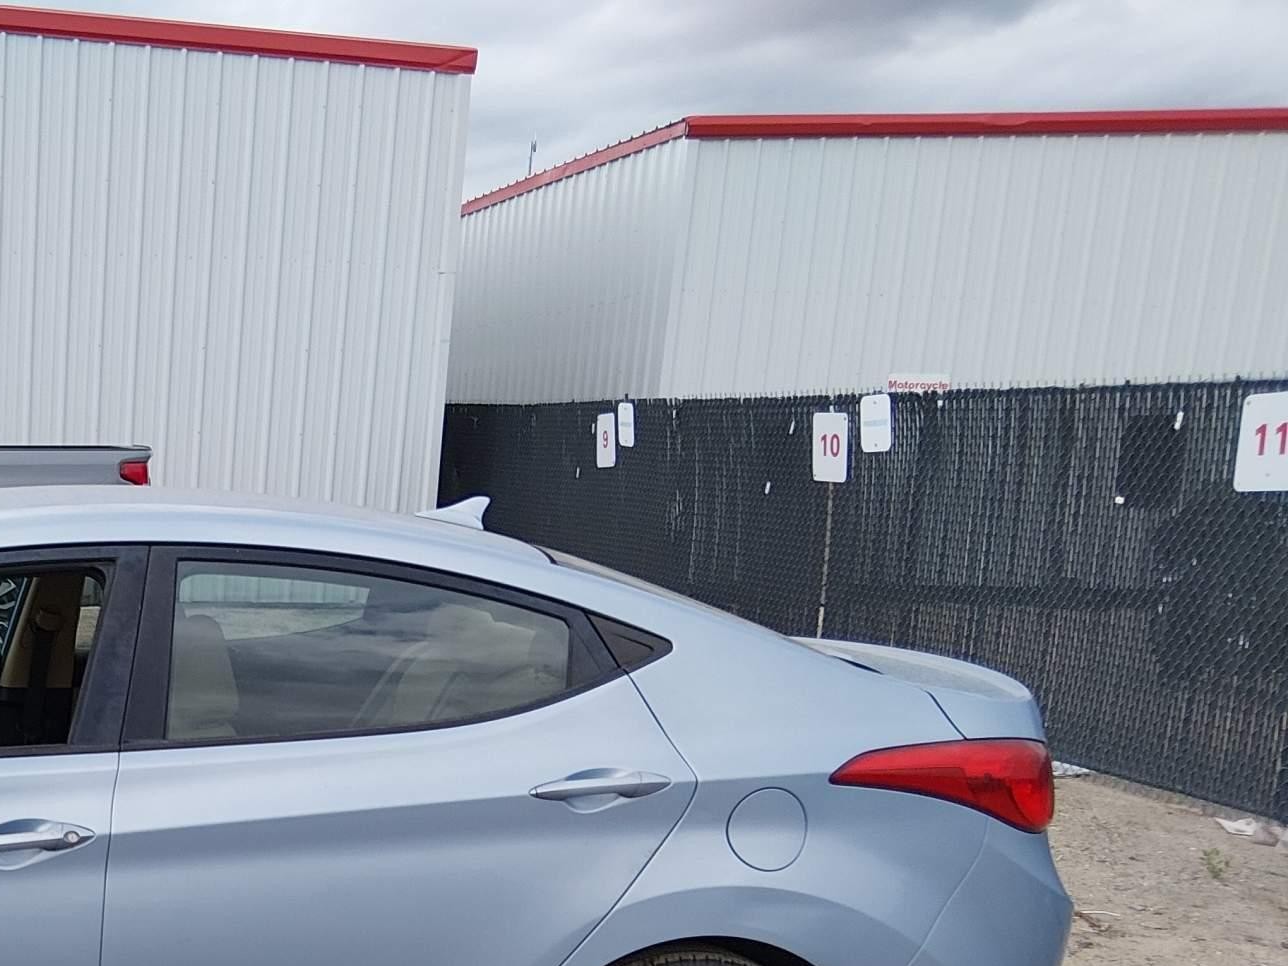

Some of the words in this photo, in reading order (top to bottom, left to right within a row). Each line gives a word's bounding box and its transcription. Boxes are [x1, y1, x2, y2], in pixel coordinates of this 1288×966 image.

[602, 430, 609, 449] 9
[820, 433, 841, 458] 10
[1255, 420, 1288, 456] 11
